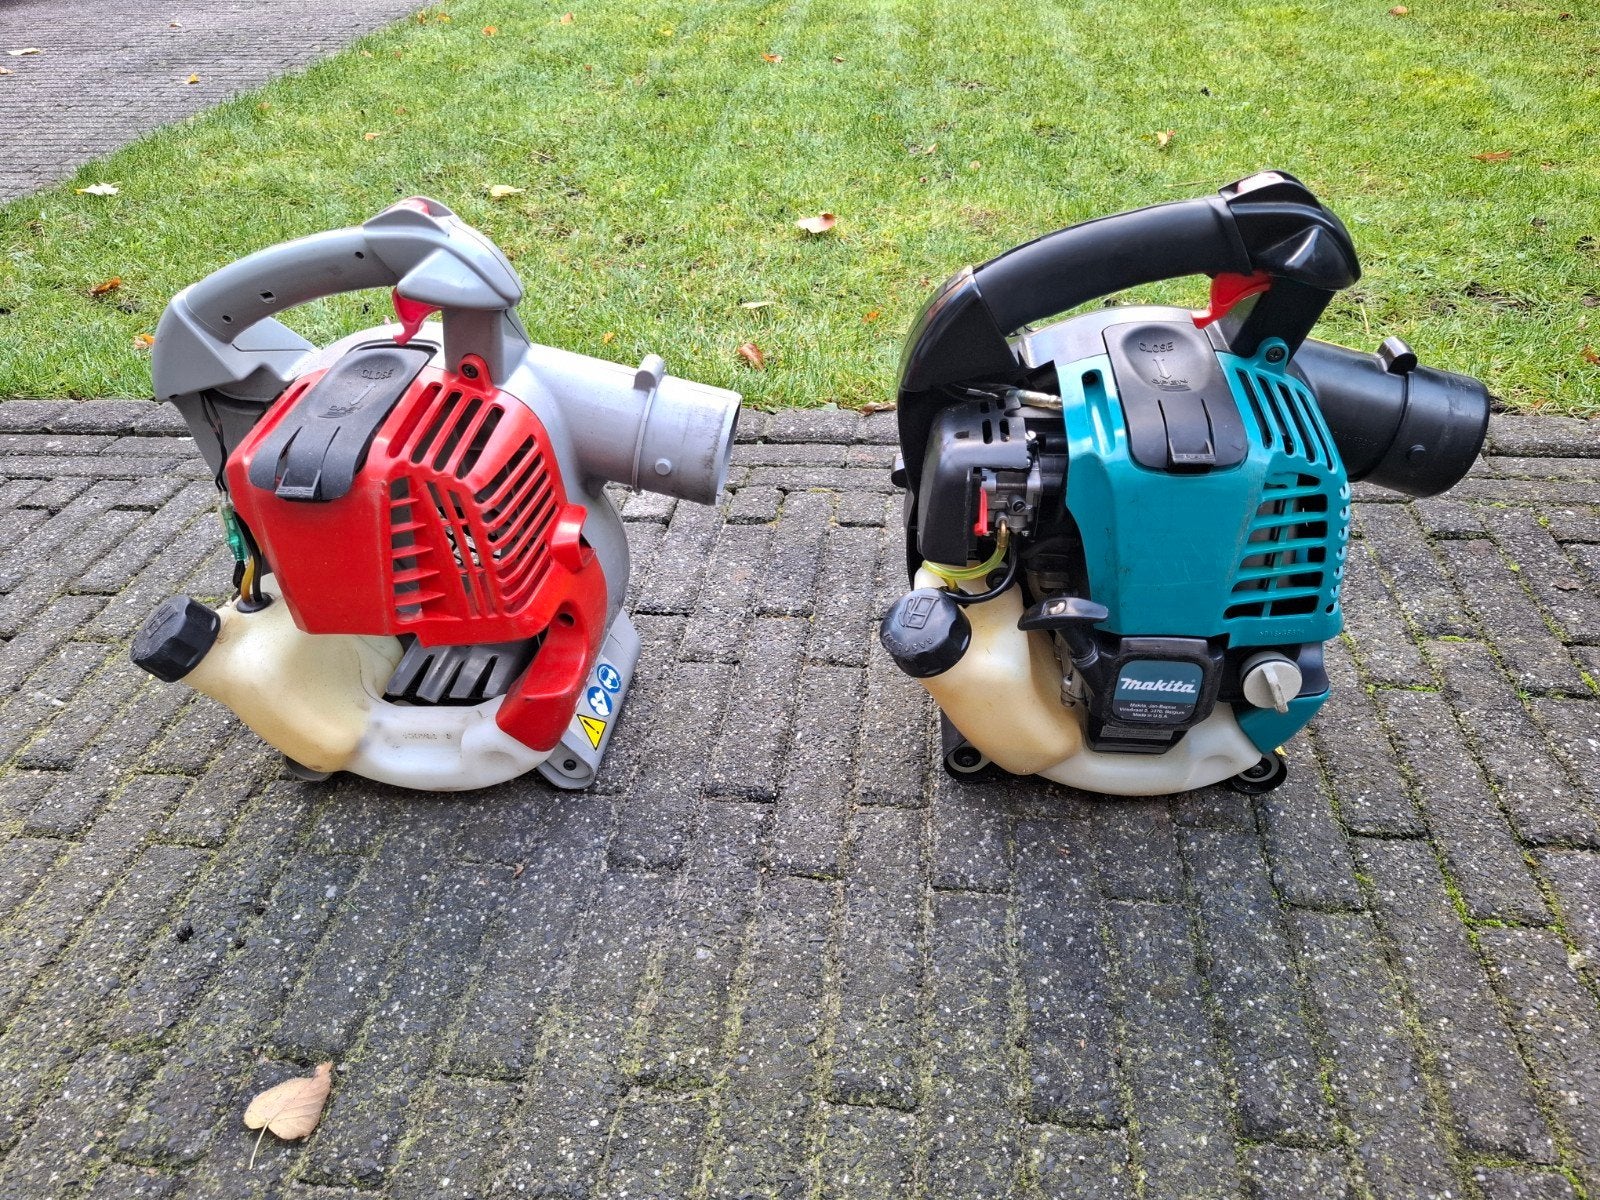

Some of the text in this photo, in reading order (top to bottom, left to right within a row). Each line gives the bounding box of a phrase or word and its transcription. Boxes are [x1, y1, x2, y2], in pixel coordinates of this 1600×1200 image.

[1138, 341, 1174, 353] CLOSE
[360, 368, 394, 380] CLOSE
[1120, 677, 1195, 693] Makita
